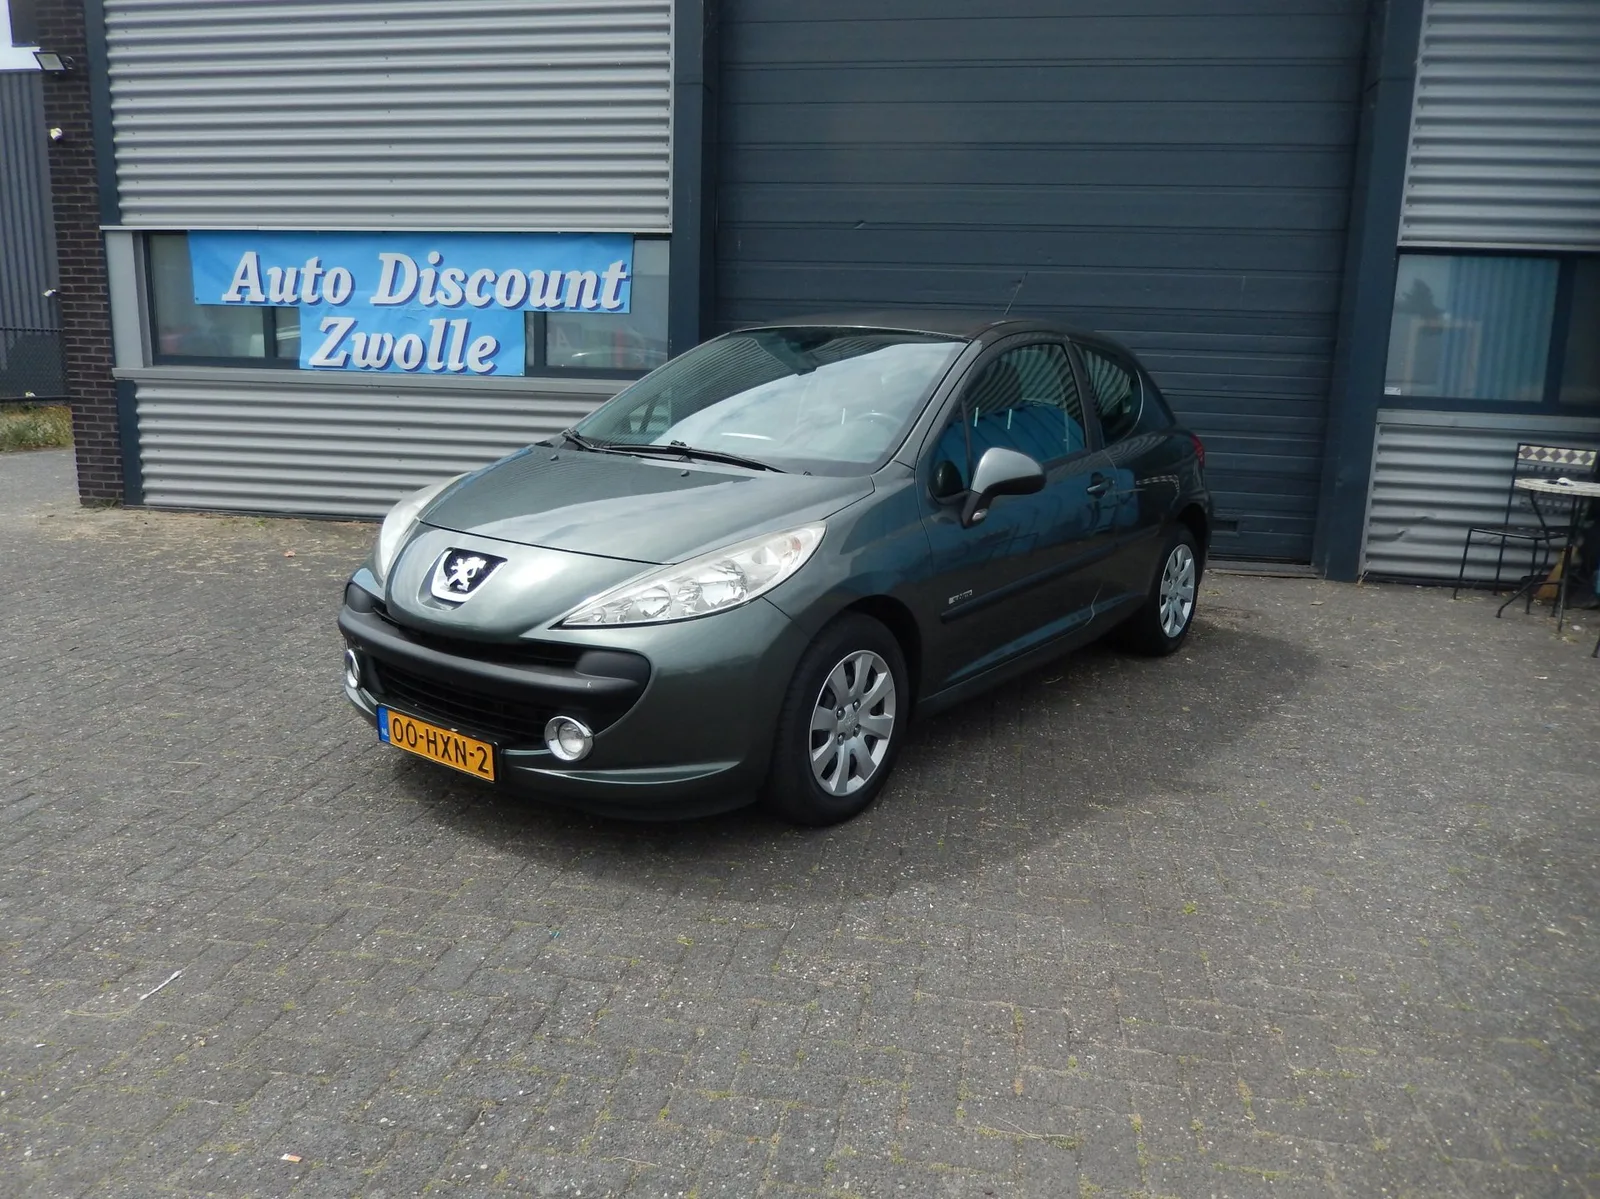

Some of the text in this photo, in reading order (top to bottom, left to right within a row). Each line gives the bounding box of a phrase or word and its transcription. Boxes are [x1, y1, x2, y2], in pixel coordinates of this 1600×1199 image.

[222, 251, 629, 310] Auto Discount
[309, 316, 499, 374] Zwolle
[392, 717, 489, 774] 00-HXN-2
